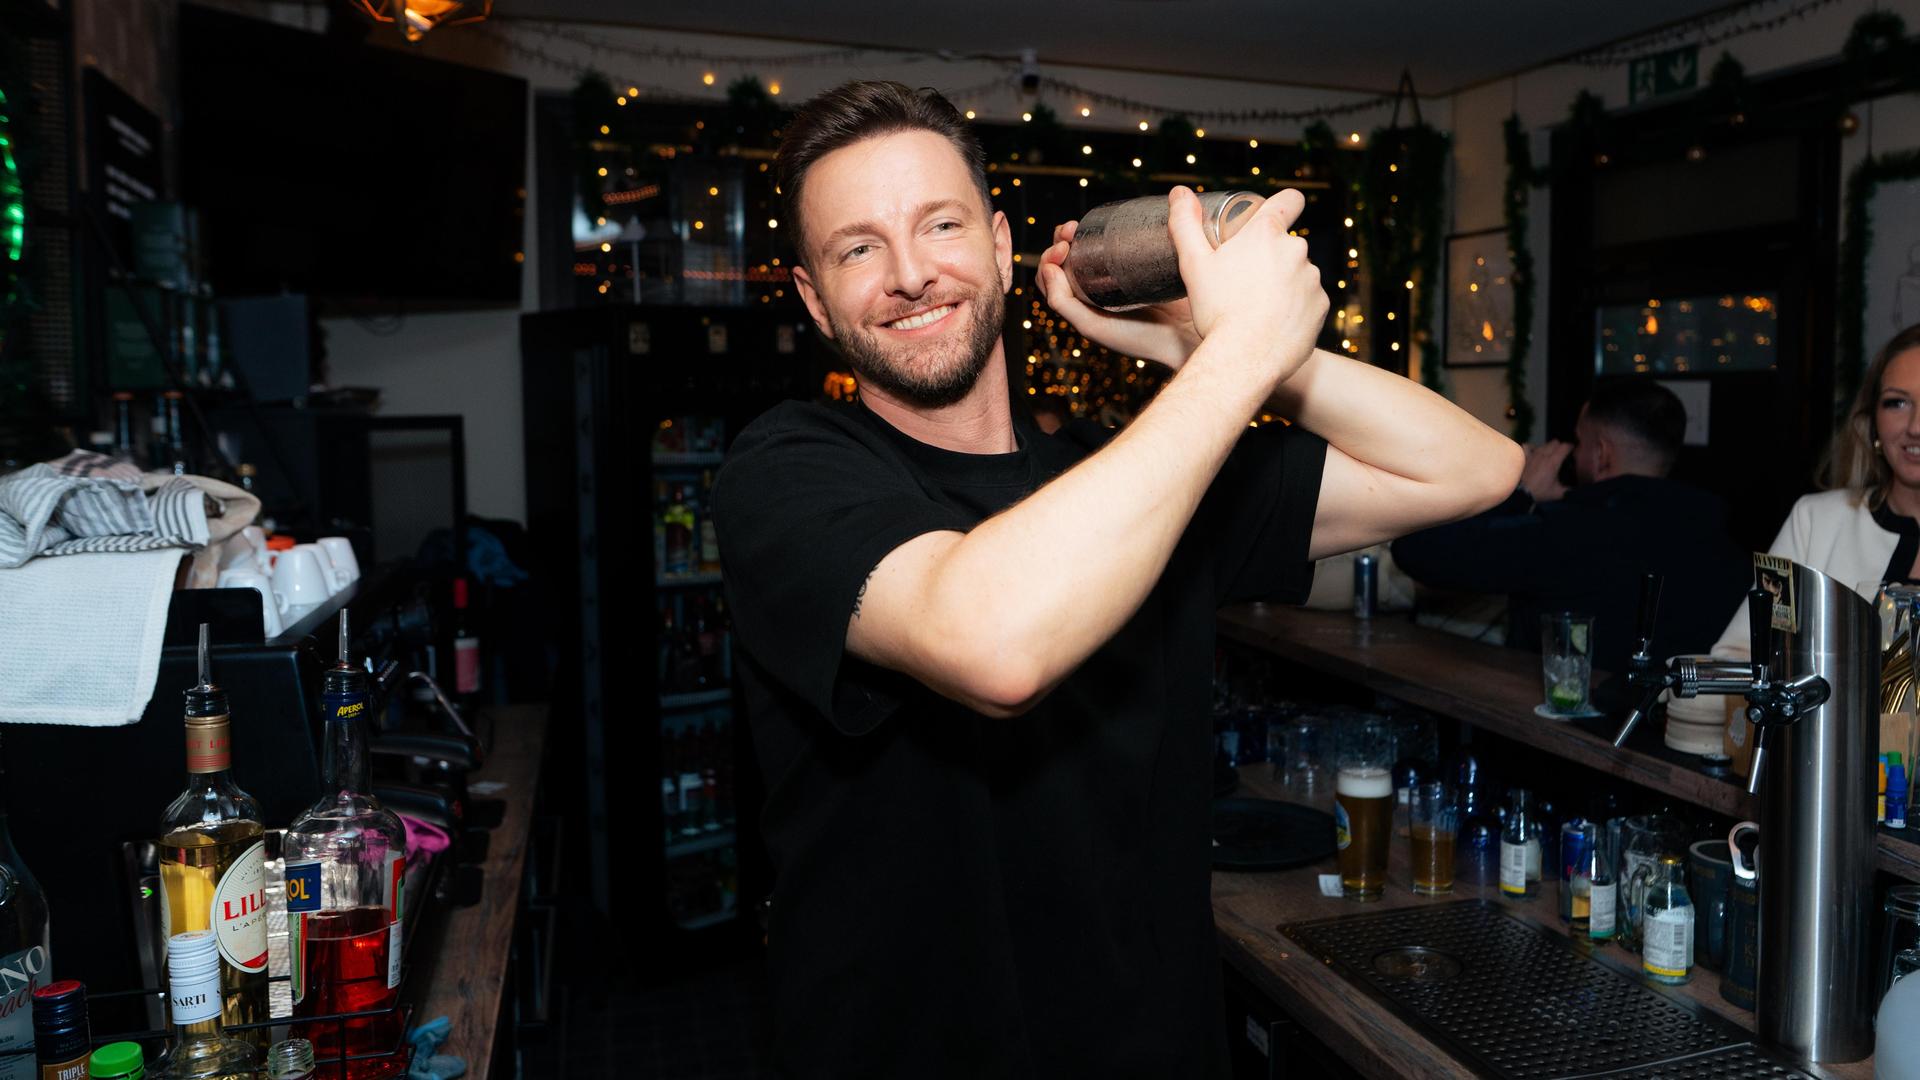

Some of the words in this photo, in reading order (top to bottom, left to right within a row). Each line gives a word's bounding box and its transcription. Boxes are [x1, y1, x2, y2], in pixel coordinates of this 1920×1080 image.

[1754, 553, 1789, 571] WANTED
[337, 702, 364, 717] APEROL
[0, 945, 46, 995] NO
[172, 993, 206, 1007] SARTI
[57, 1063, 86, 1080] TRIPLE
